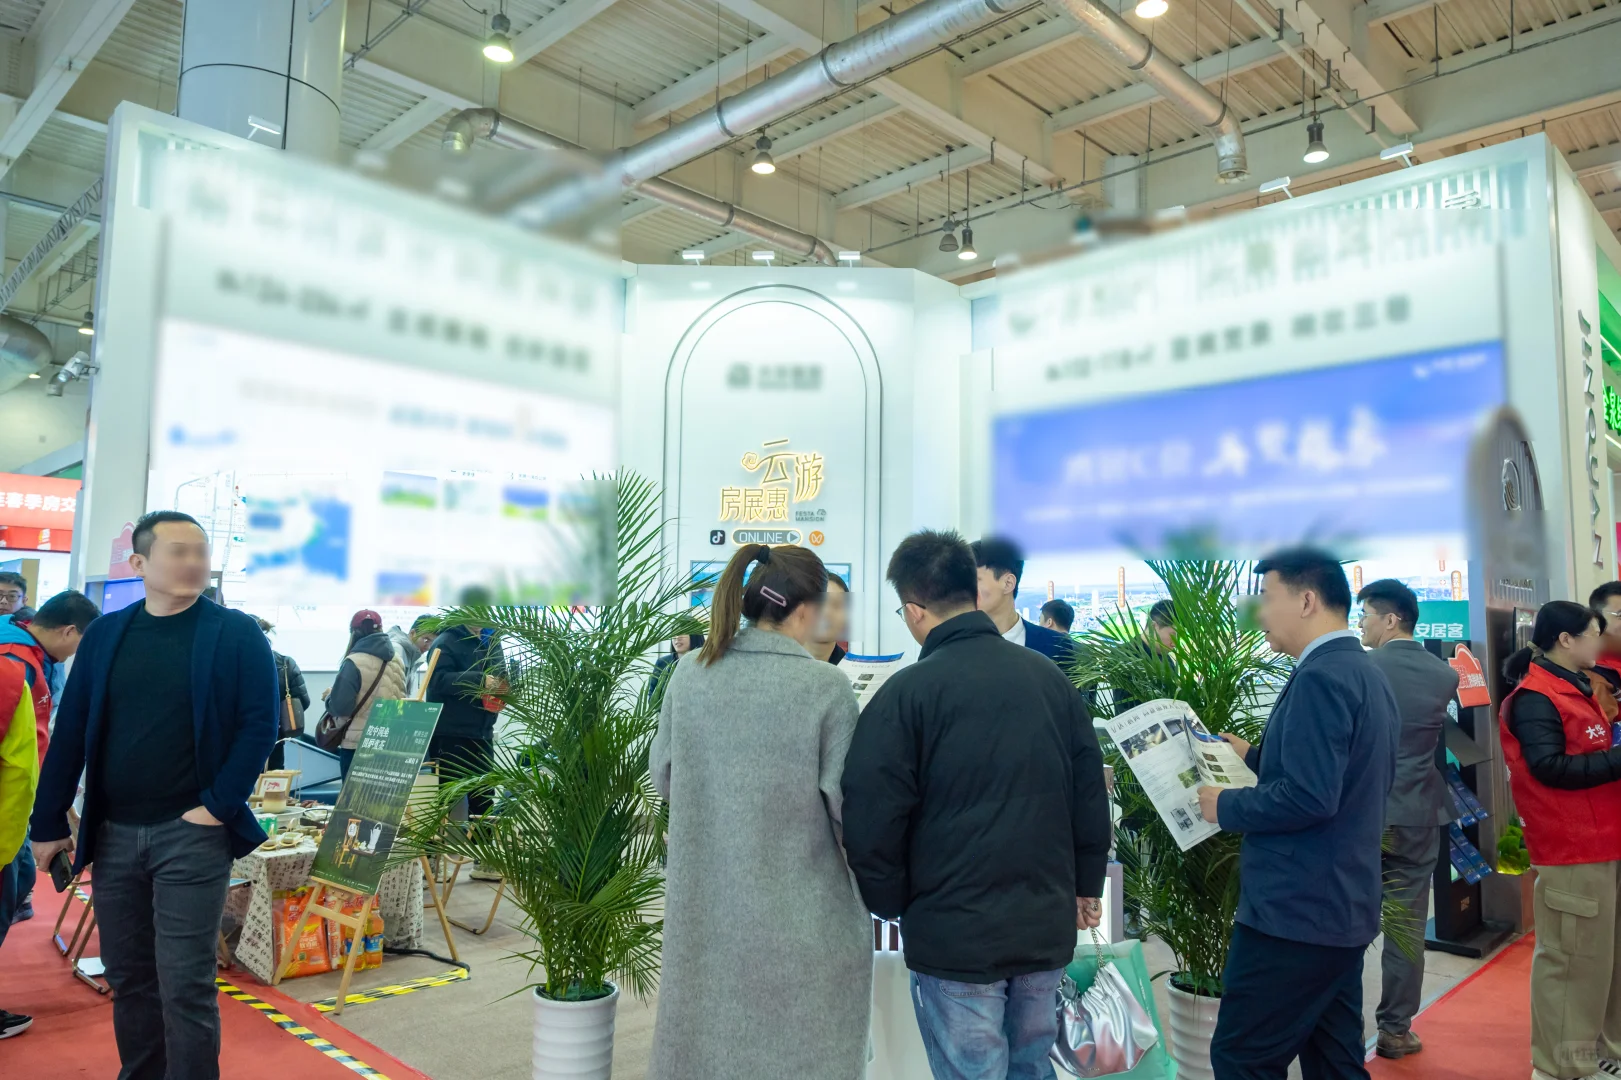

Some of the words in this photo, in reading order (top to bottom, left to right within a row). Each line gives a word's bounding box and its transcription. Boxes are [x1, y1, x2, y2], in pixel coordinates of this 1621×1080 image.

[742, 439, 823, 502] 云游
[720, 486, 788, 522] 房展惠
[738, 532, 783, 543] ONLINE
[1414, 622, 1464, 639] 安居客
[1585, 724, 1606, 740] 大华
